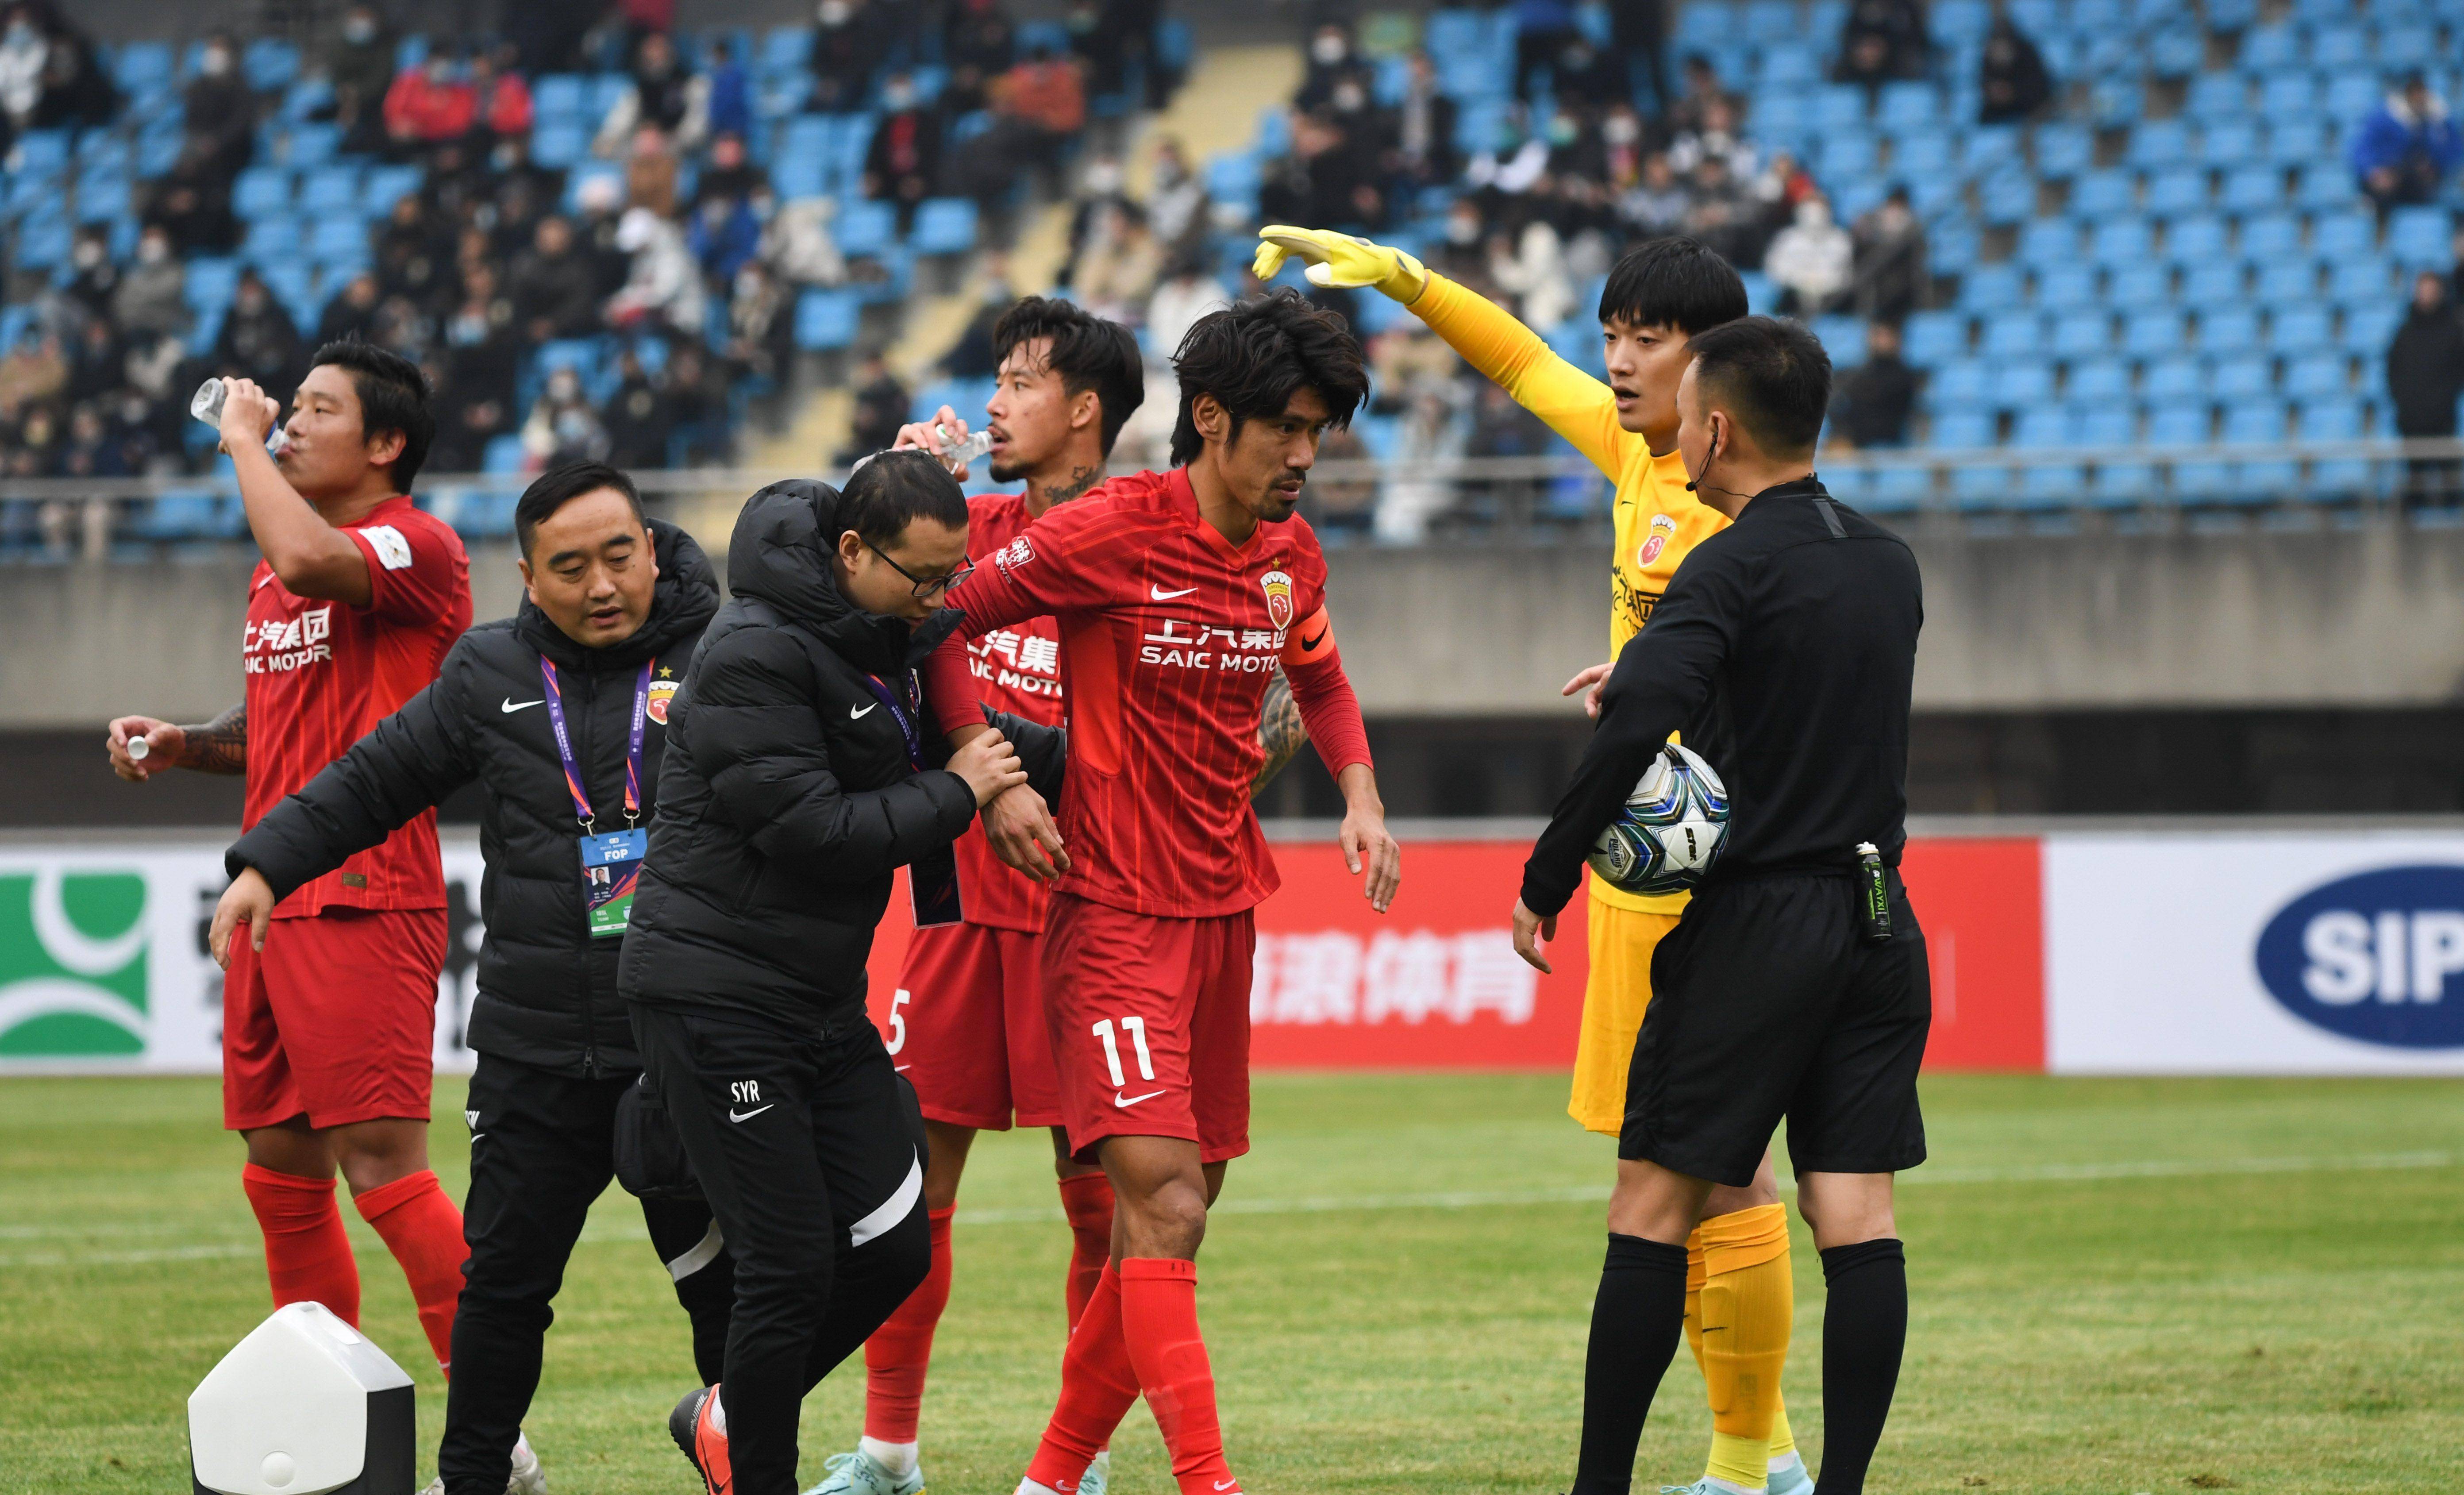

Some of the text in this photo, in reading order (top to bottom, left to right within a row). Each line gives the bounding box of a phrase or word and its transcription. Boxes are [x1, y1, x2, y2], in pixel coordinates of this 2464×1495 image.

[967, 630, 1059, 675] 汽集
[1140, 646, 1282, 673] SAIC MOTO
[997, 668, 1062, 697] MOT
[604, 848, 628, 861] FOP
[1610, 838, 1622, 868] POLARIS
[1874, 877, 1885, 910] WAYXI
[1093, 1016, 1155, 1087] 11
[731, 1080, 760, 1103] SYR
